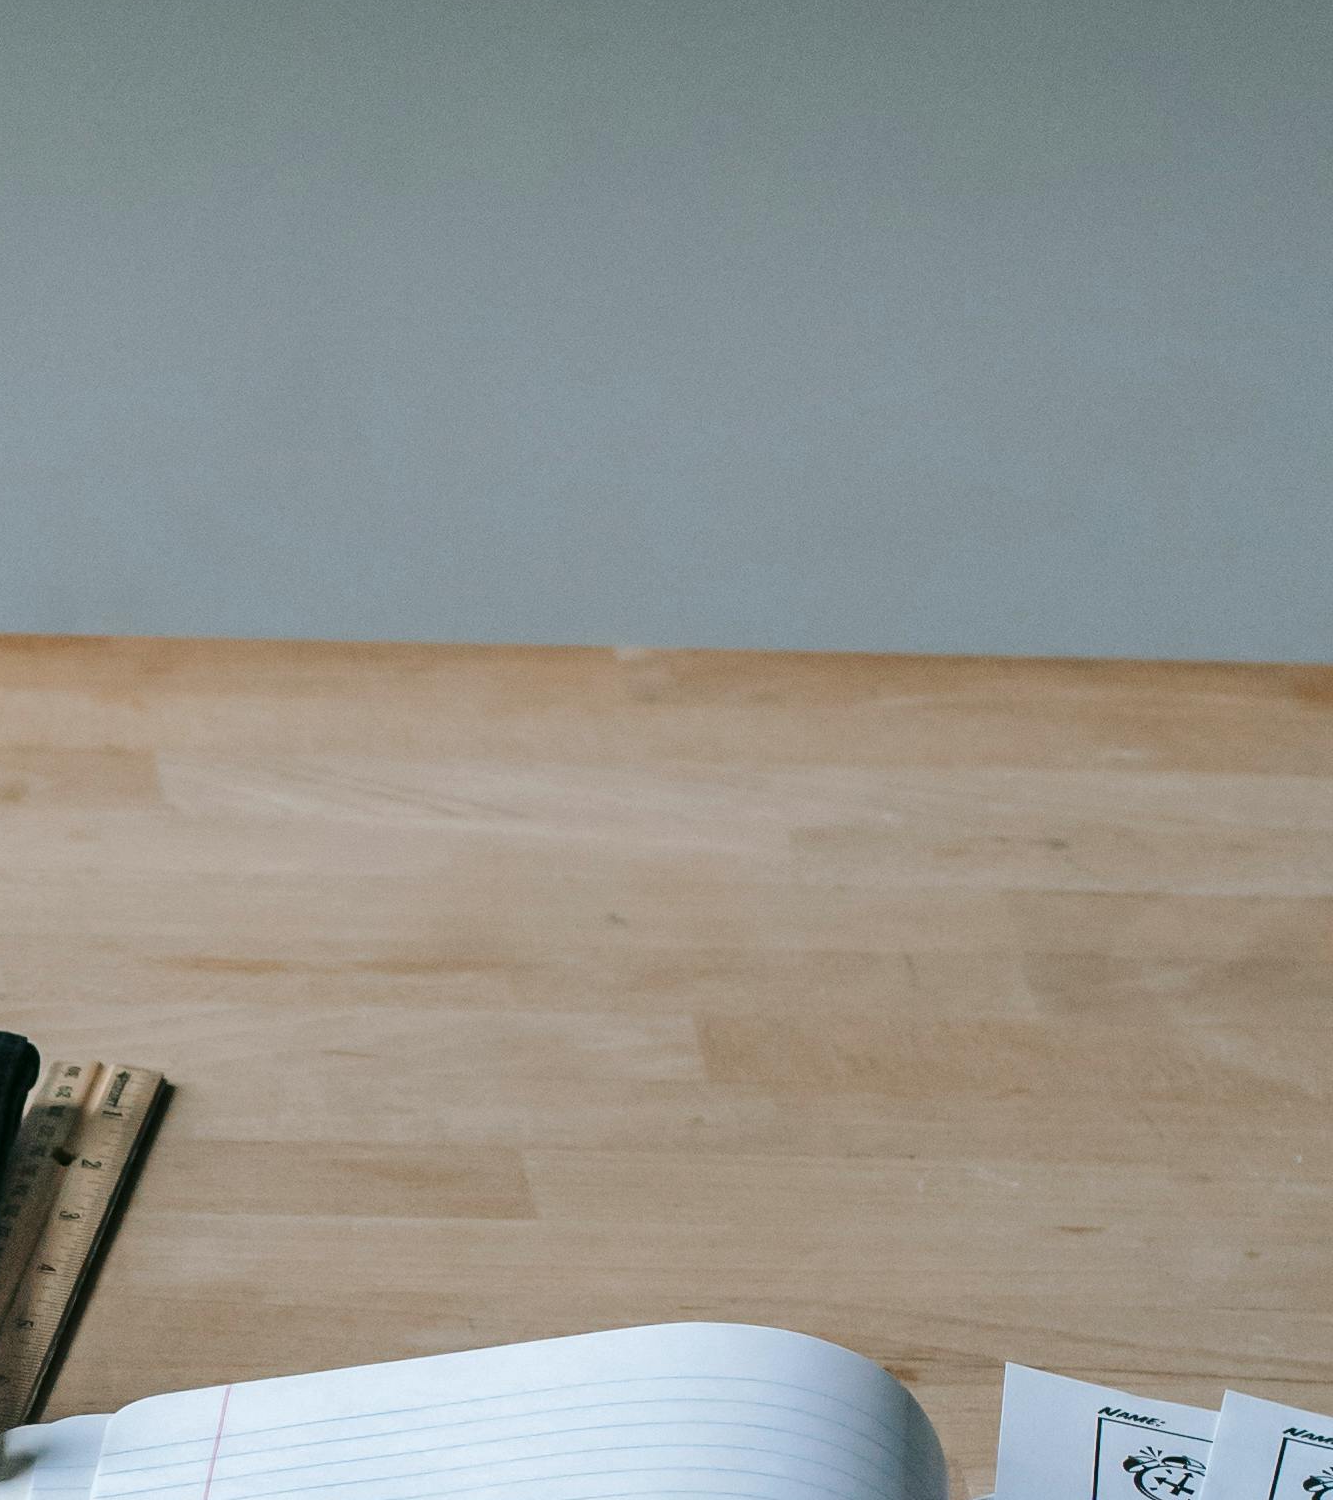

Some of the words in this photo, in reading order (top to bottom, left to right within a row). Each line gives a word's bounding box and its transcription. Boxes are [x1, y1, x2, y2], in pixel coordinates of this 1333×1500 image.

[81, 1159, 102, 1171] 2
[60, 1210, 81, 1221] 3
[1098, 1406, 1166, 1427] NAME:
